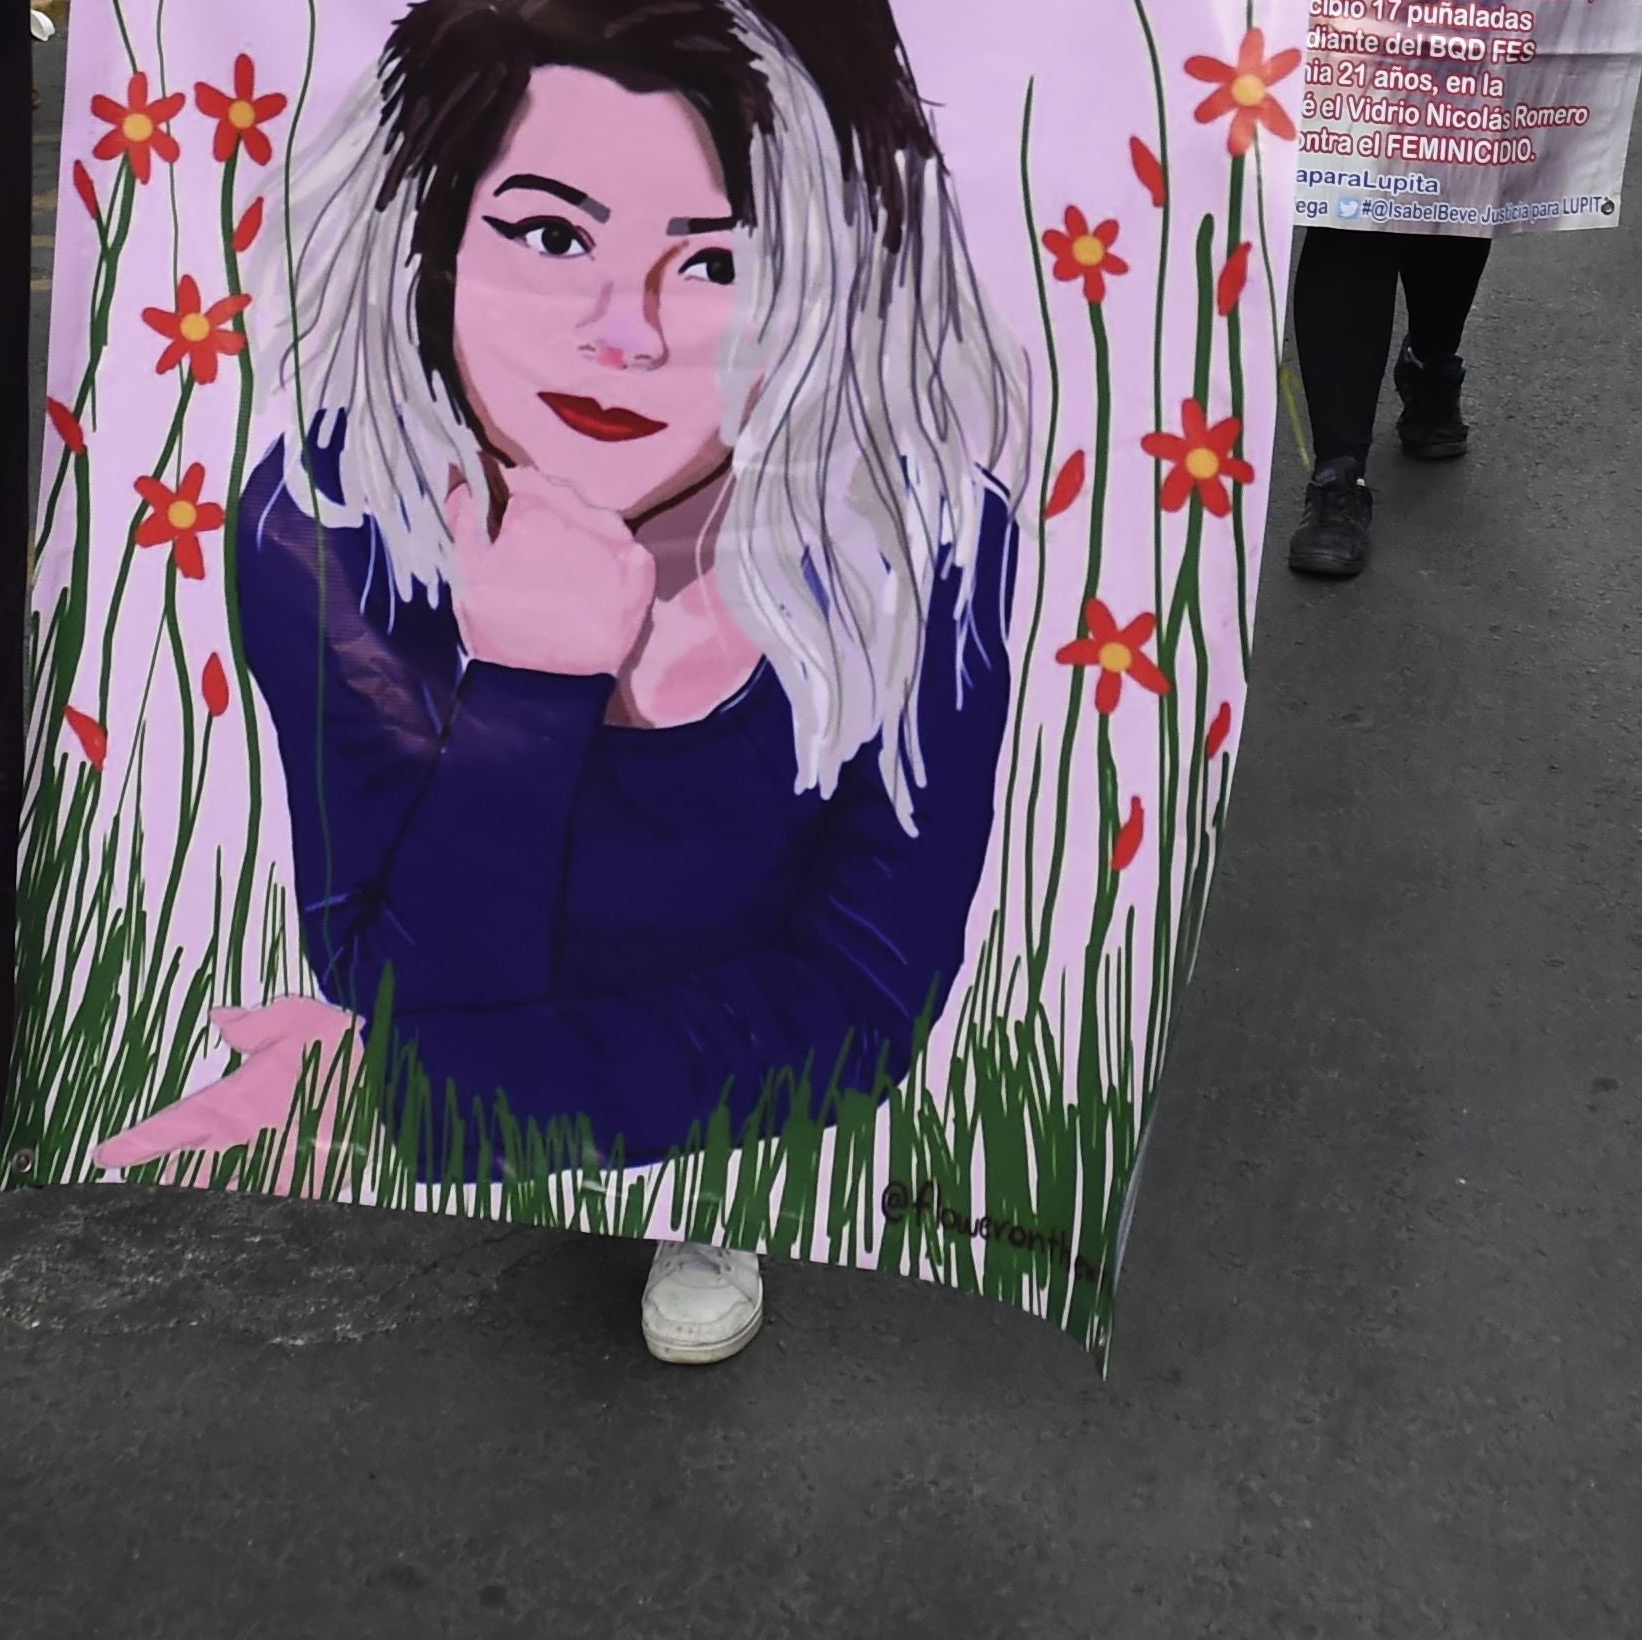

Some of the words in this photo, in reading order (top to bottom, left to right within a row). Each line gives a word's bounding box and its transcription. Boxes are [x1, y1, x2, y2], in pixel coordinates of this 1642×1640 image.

[1407, 0, 1533, 31] puñaladas
[1385, 32, 1423, 57] del
[1492, 40, 1536, 65] FES
[1337, 63, 1367, 88] 21
[1373, 65, 1439, 96] años,
[1445, 74, 1476, 95] en
[1482, 71, 1505, 98] la
[1322, 94, 1342, 120] el
[1347, 95, 1421, 126] Vidrio
[1425, 102, 1511, 131] Nicolás
[1514, 104, 1590, 130] Romero
[1357, 130, 1381, 157] el
[1385, 132, 1537, 164] FEMINICIDIO.
[1480, 198, 1531, 226] Justicia
[1531, 202, 1561, 223] para
[1562, 195, 1614, 216] LUPIT
